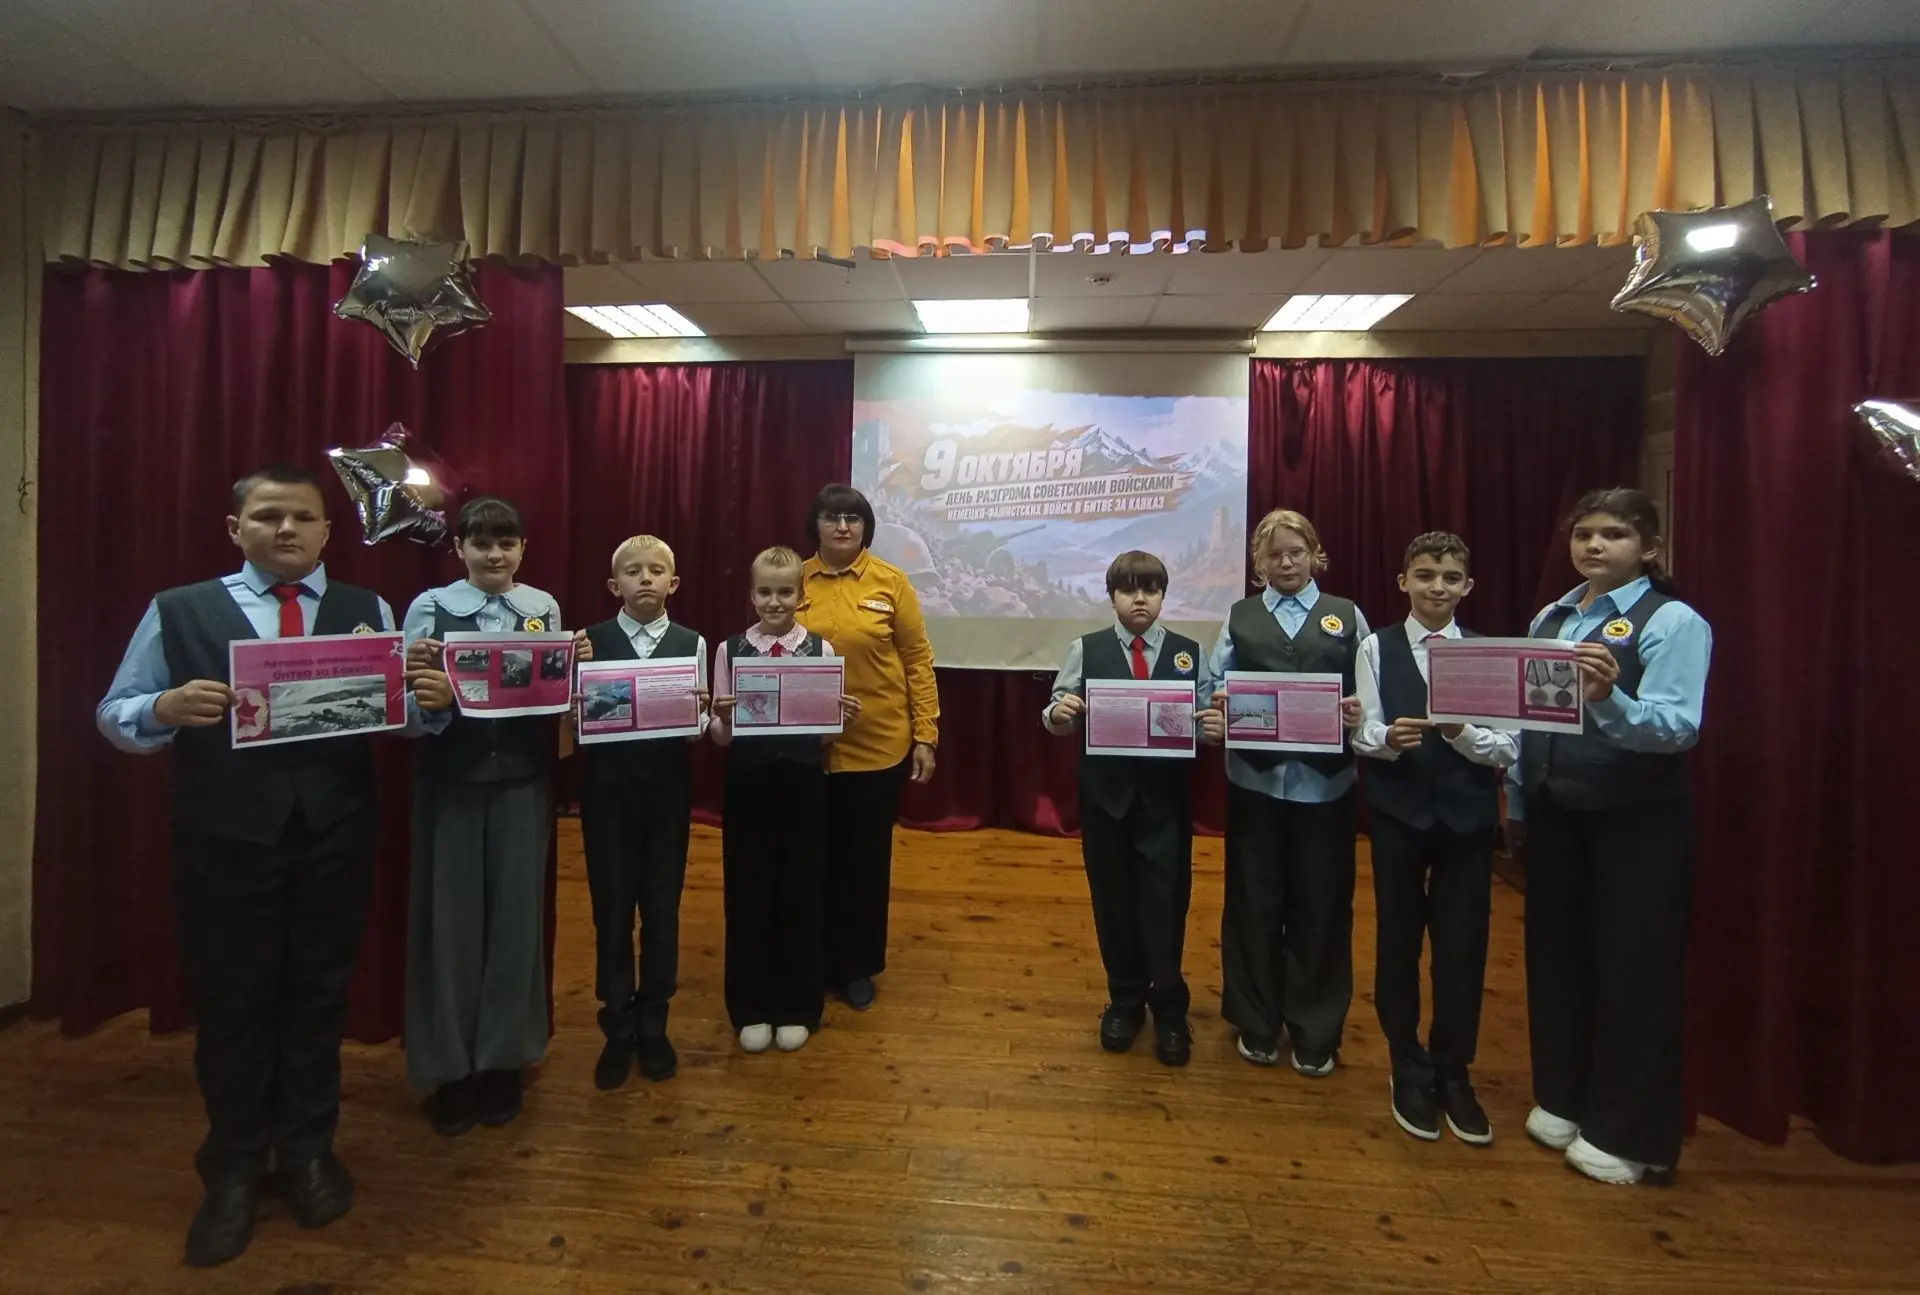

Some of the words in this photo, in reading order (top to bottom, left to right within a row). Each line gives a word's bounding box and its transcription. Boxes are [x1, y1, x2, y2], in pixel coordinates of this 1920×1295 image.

[921, 439, 957, 490] 9
[957, 450, 1083, 485] ОКТЯБРЯ
[946, 489, 973, 506] ДЕНЬ
[976, 486, 1031, 504] РАЗГРОМА
[1033, 479, 1107, 499] СОВЕТСКИМИ
[1110, 475, 1174, 494] ВОЙСКАМИ
[1043, 499, 1073, 516] ВОЙСК
[1075, 500, 1082, 514] В
[1084, 498, 1113, 514] БИТВЕ
[1115, 498, 1127, 512] ЗА
[1128, 495, 1165, 511] КАВКАЗ
